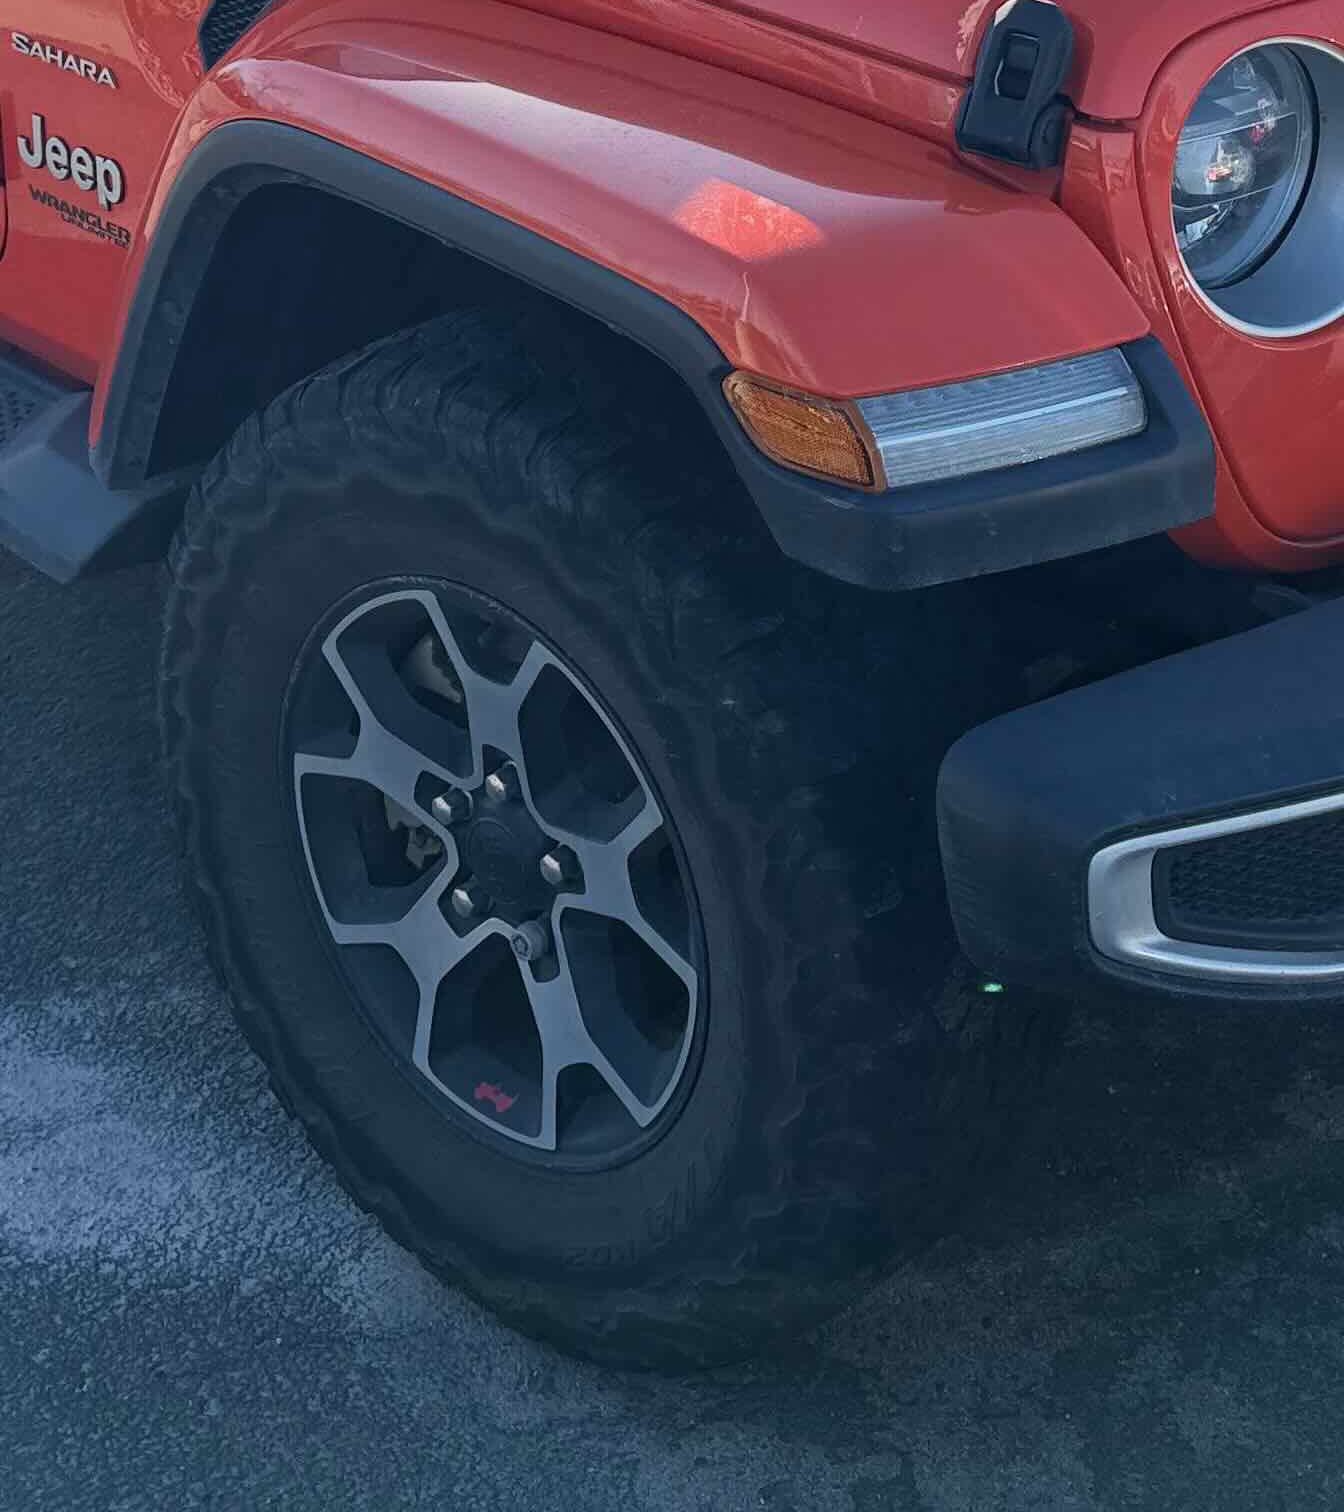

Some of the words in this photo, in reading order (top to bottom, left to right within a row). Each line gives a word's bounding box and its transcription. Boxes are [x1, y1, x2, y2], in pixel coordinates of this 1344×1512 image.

[11, 31, 117, 89] SAHARA
[17, 112, 126, 211] Jeep
[28, 184, 131, 245] WRANGLER
